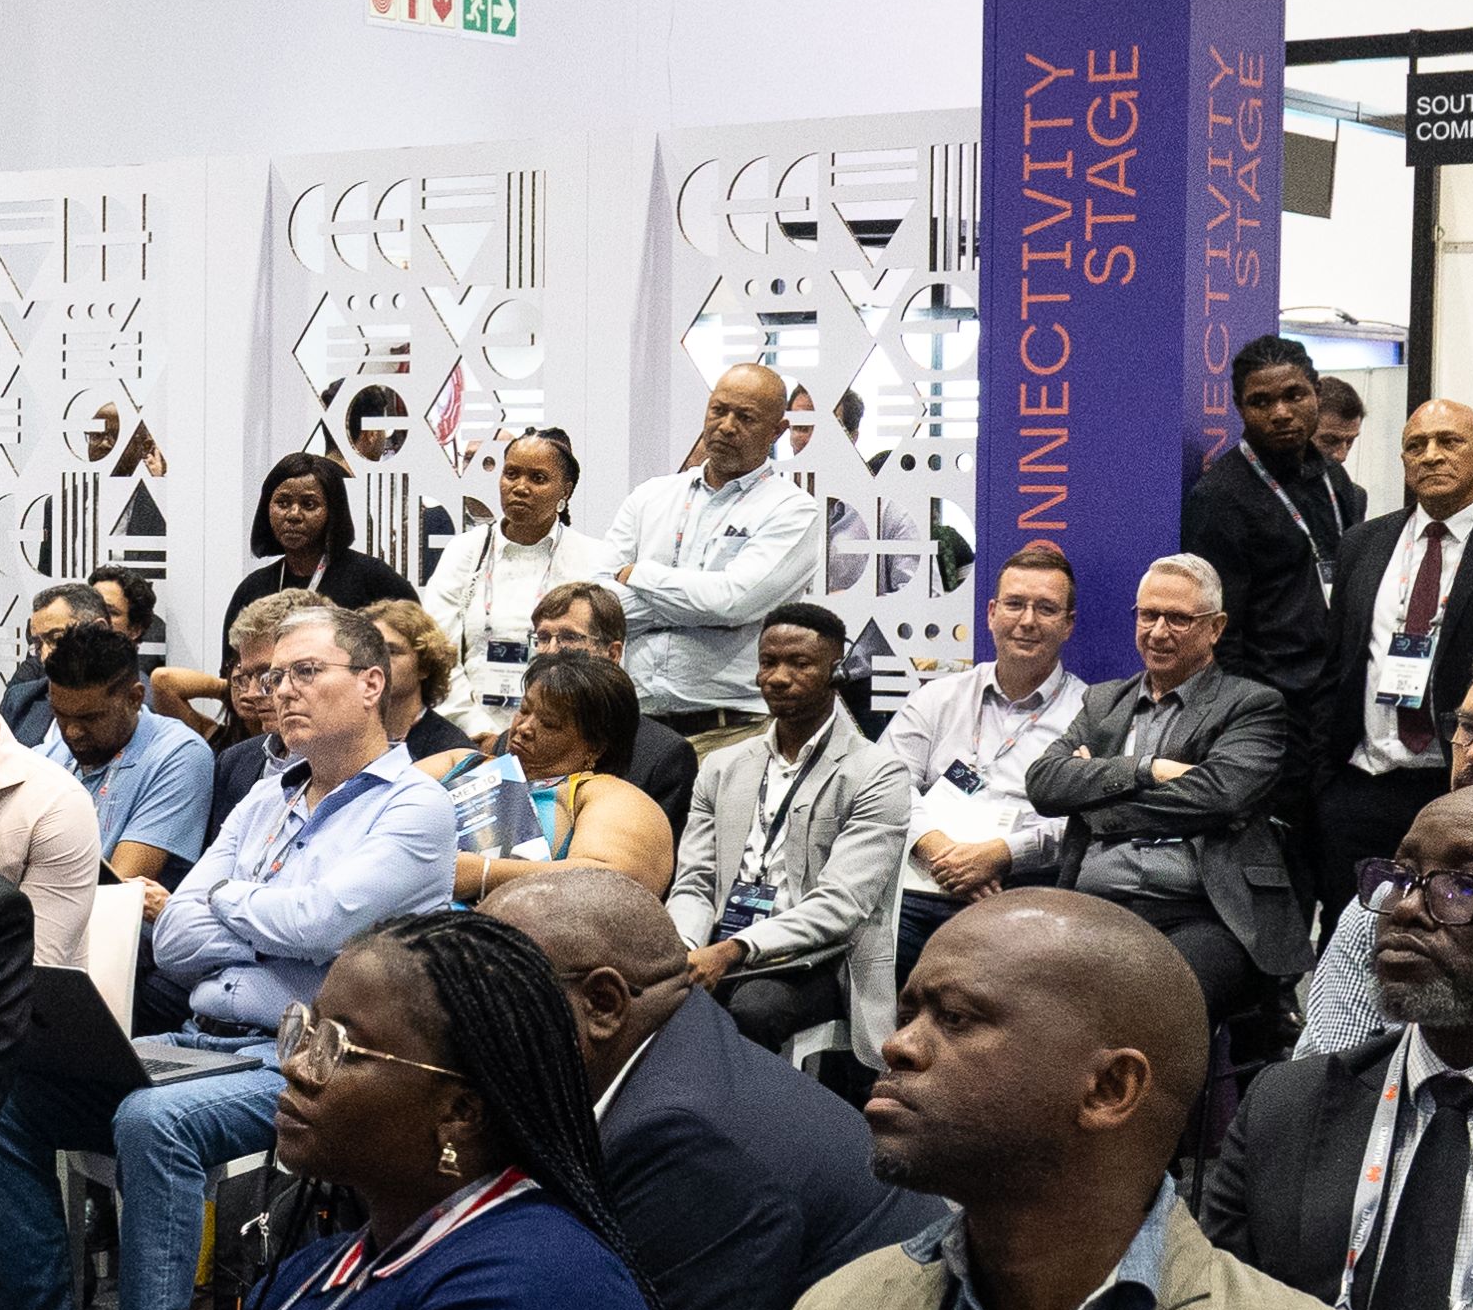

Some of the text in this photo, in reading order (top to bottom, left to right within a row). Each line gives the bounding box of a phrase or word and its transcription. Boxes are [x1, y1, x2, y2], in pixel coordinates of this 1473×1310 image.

[1084, 45, 1141, 287] STAGE
[1202, 46, 1235, 472] NECTIVITY
[1235, 53, 1264, 287] STAGE
[1018, 53, 1075, 553] NNECTIVITY
[1352, 1208, 1371, 1250] HUAWEI
[1374, 1126, 1389, 1165] HUAWEI
